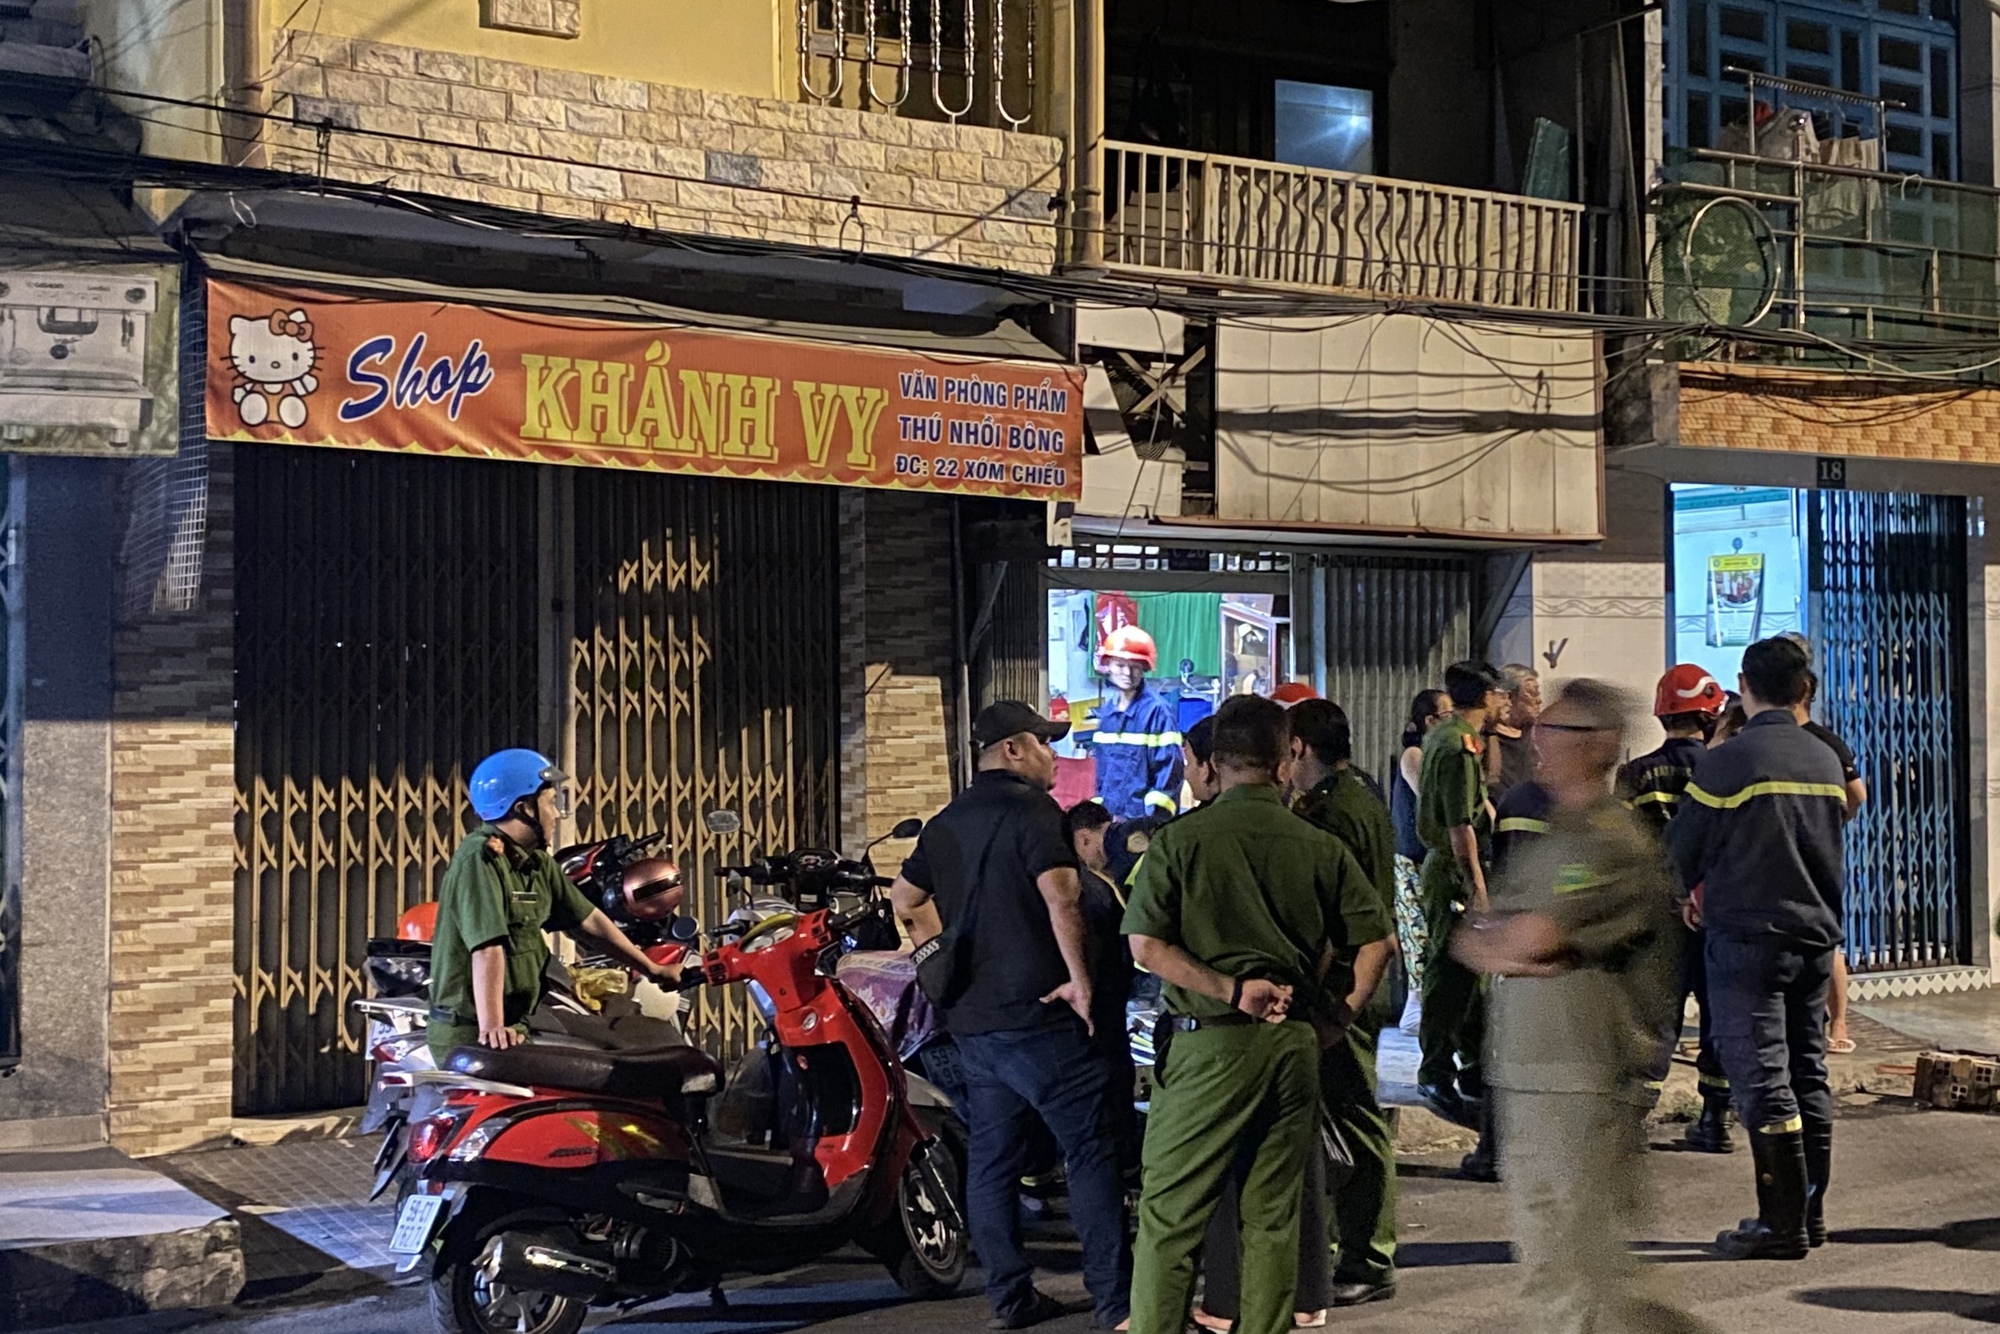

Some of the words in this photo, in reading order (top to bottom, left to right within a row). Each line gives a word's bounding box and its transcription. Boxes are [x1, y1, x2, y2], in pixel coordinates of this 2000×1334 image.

[338, 331, 494, 421] Shop
[519, 340, 780, 464] KHÁNH
[793, 380, 889, 472] VY
[899, 369, 938, 400] VĂN
[944, 374, 1007, 408] PHÒNG
[1014, 377, 1067, 415] PHẨM
[898, 412, 942, 443] THÚ
[949, 414, 1001, 448] NHỒI
[1008, 421, 1064, 454] BÔNG
[894, 454, 928, 476] ĐC:
[934, 458, 959, 479] 22
[963, 455, 1005, 482] XÓM
[1011, 461, 1066, 487] CHIẾU
[1820, 460, 1843, 481] 18
[930, 1048, 954, 1067] 59-
